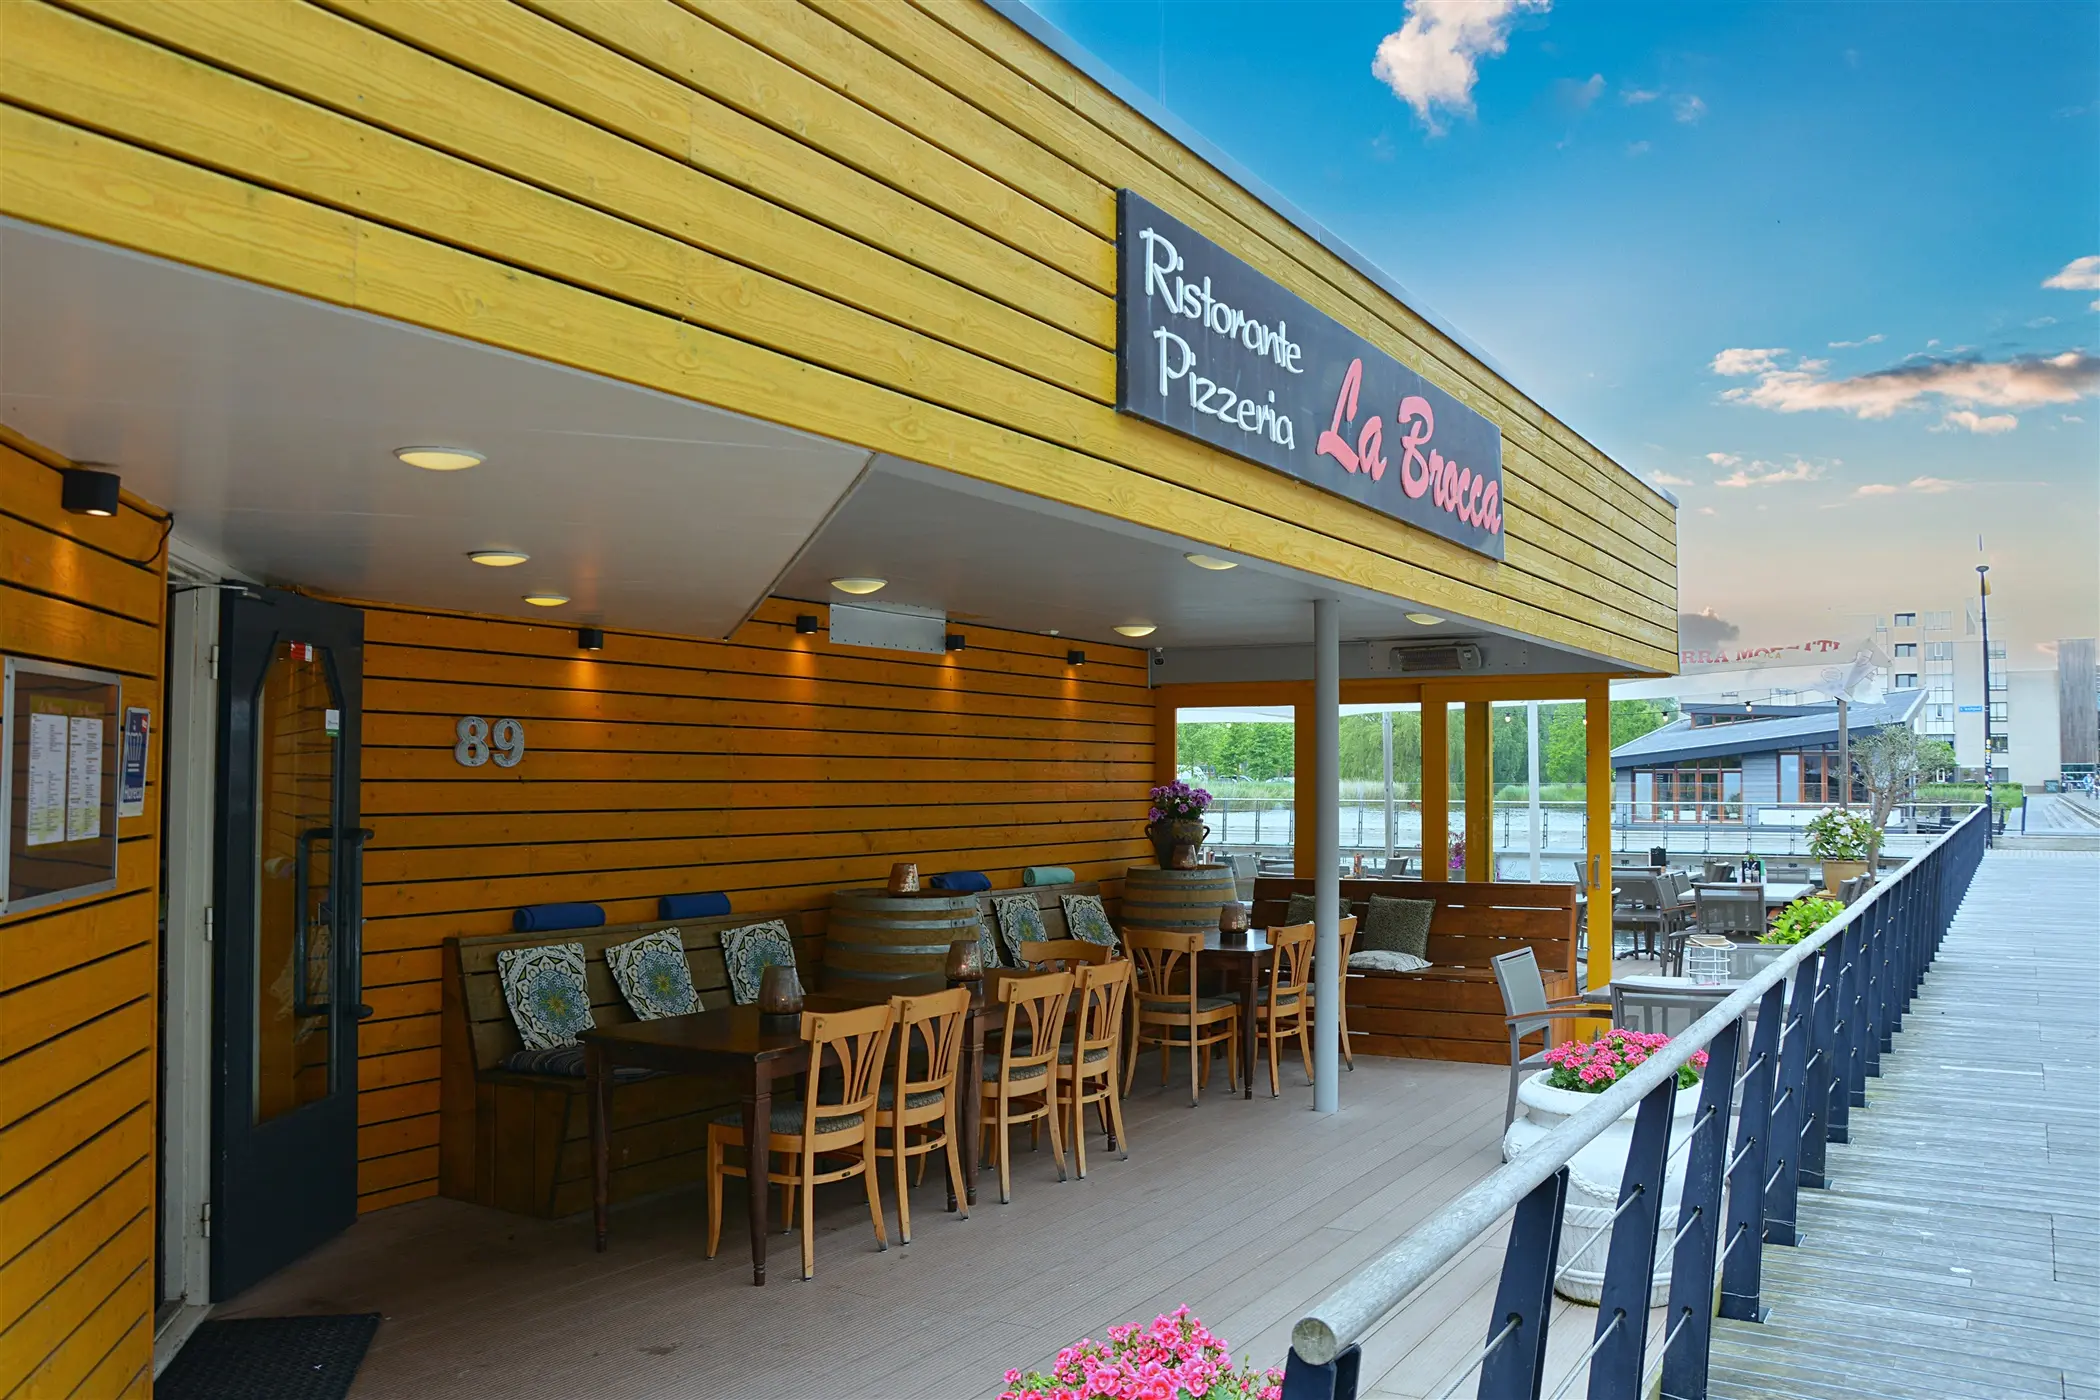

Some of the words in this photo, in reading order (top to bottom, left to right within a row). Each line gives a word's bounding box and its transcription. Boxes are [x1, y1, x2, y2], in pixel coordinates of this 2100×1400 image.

[1139, 227, 1304, 374] Ristorante
[1153, 326, 1296, 451] Pizzeria
[1315, 357, 1388, 481] La
[1397, 395, 1502, 535] Brocca
[1680, 649, 1730, 665] RRA
[454, 715, 525, 768] 89
